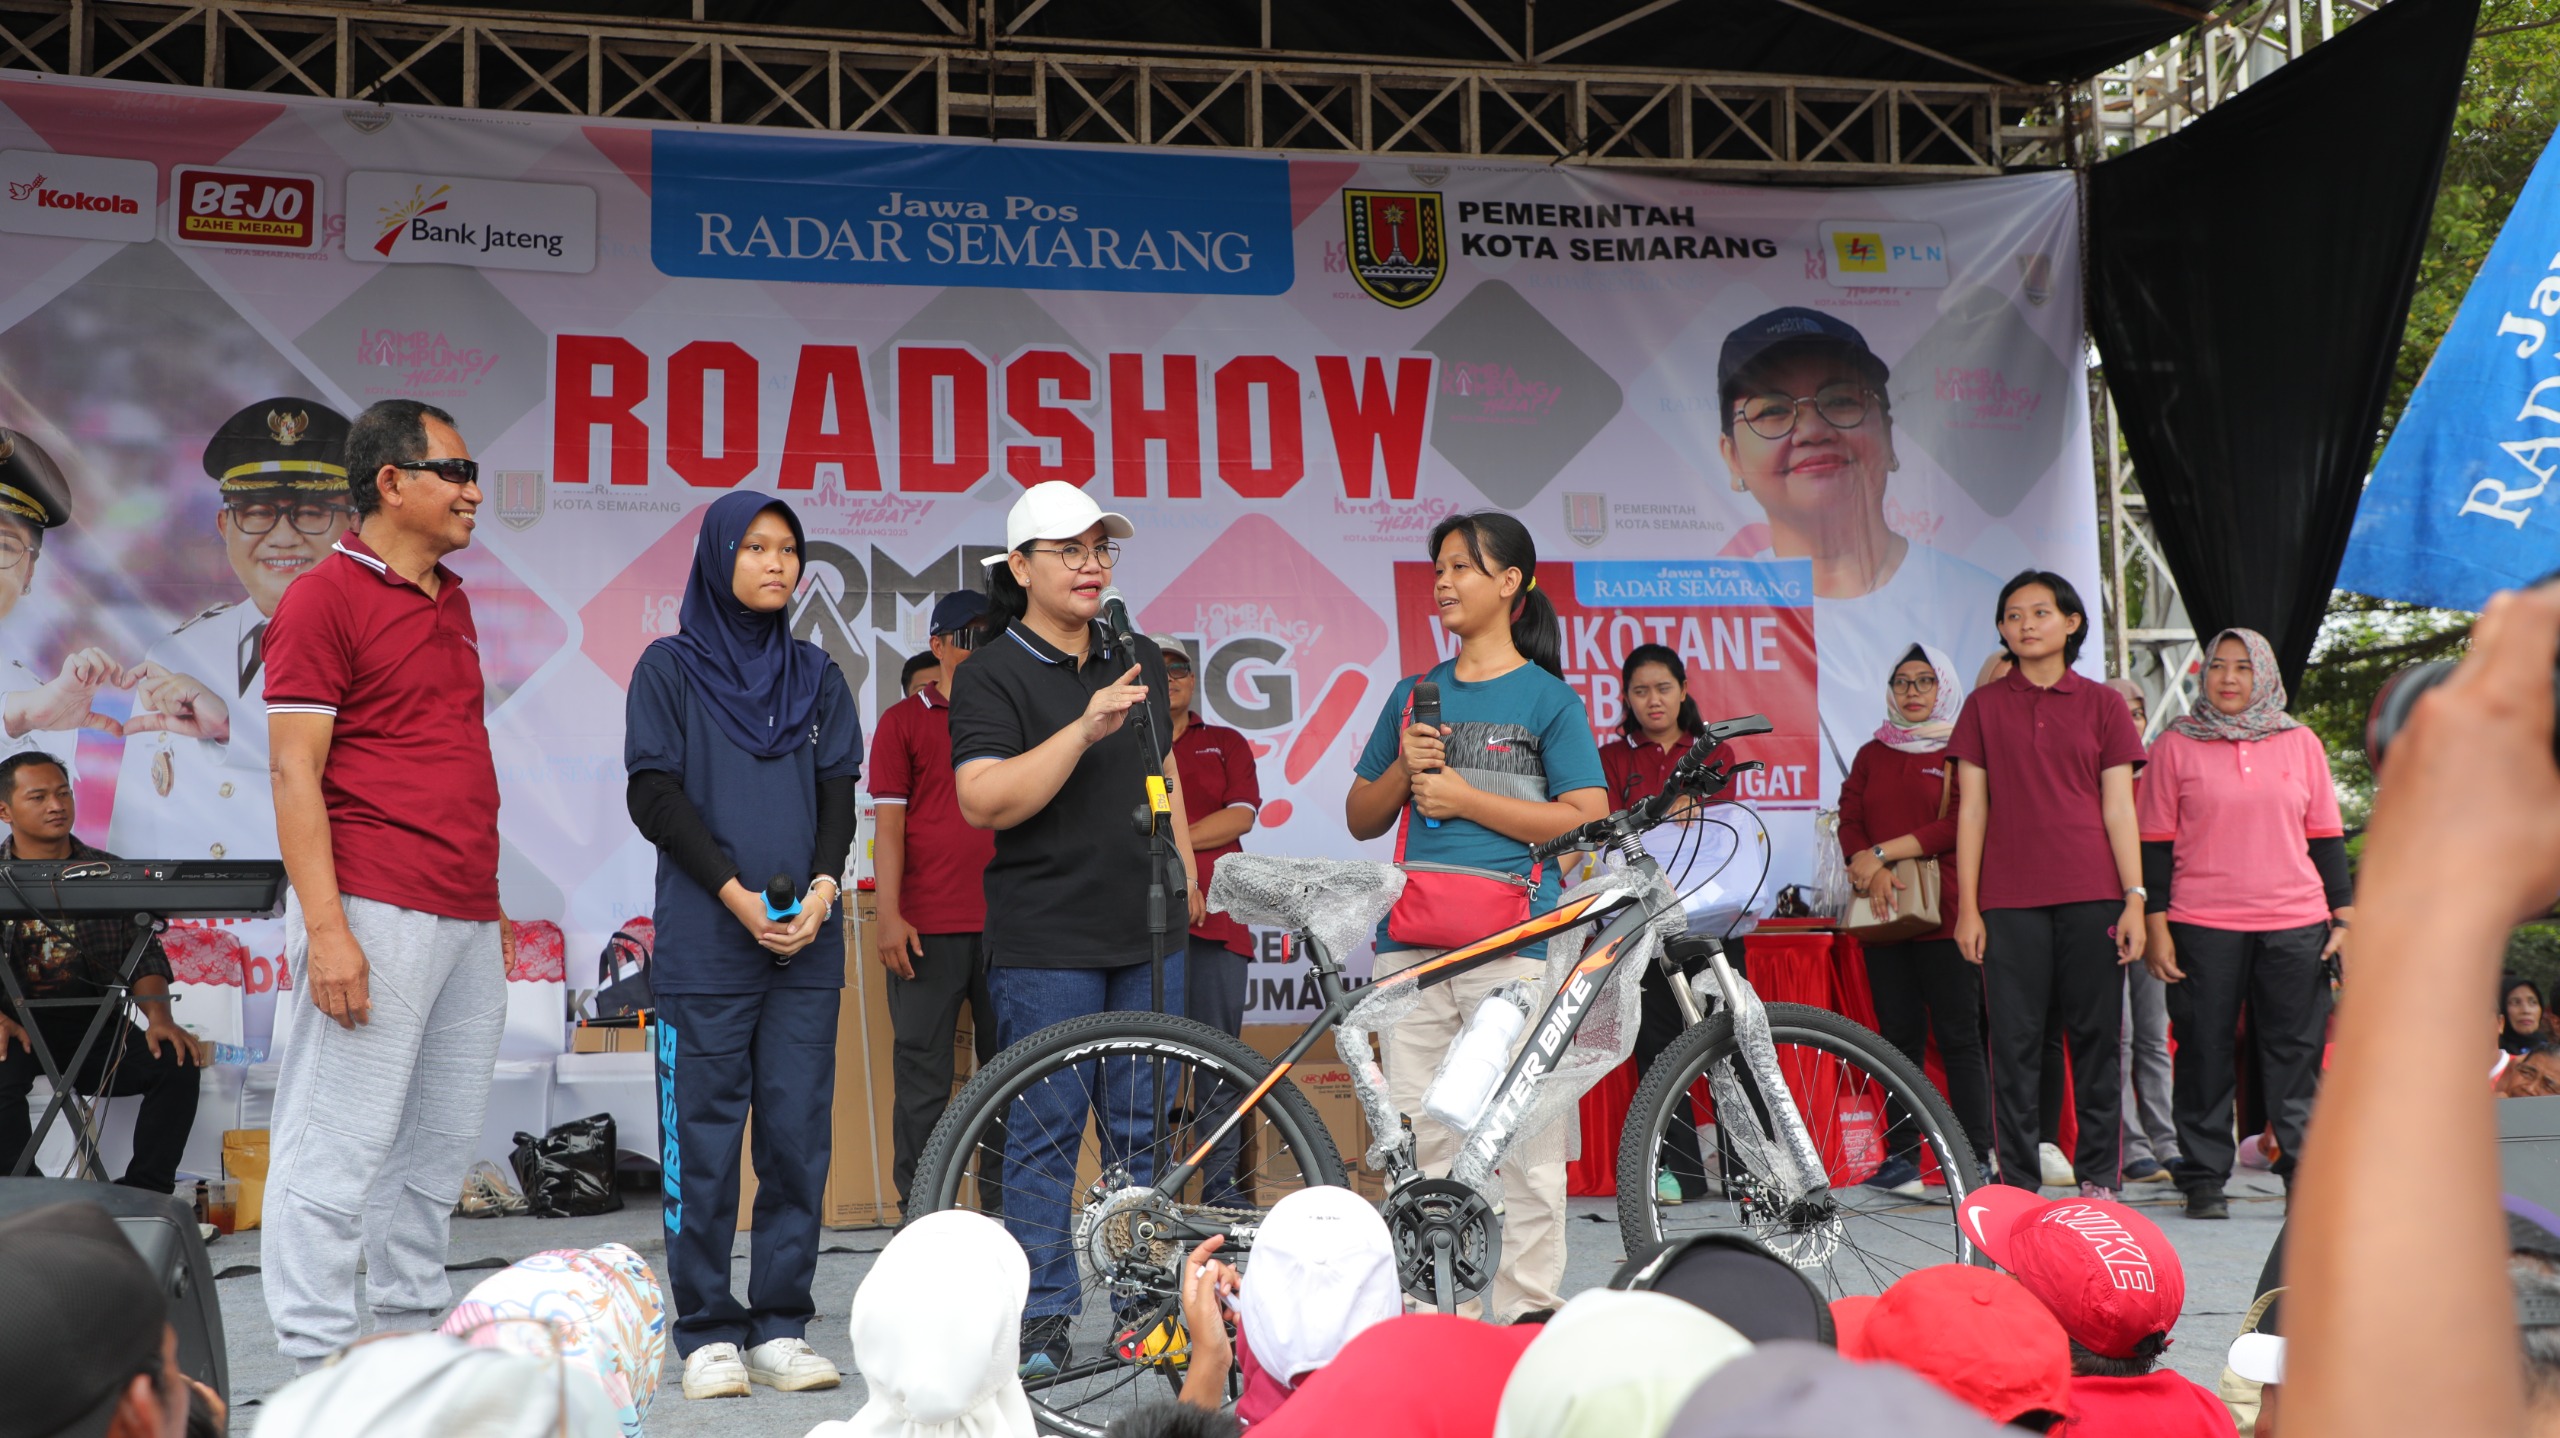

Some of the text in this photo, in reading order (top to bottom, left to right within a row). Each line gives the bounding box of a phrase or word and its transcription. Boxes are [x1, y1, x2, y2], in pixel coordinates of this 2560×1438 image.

[38, 189, 139, 214] Kokola
[190, 180, 304, 221] BEJO
[878, 192, 1079, 222] Jawa Pos
[192, 218, 295, 235] JAHE MERAH
[1458, 201, 1696, 229] PEMERINTAH
[411, 218, 477, 245] Bank
[481, 224, 564, 257] Jateng
[695, 212, 1253, 273] RADAR SEMARANG
[1461, 233, 1778, 262] KOTA SEMARANG
[1892, 245, 1943, 262] PLN
[552, 333, 1433, 500] ROADSHOW
[553, 499, 682, 513] KOTA SEMARANG
[1614, 503, 1696, 516] PEMERINTAH
[1615, 519, 1725, 532] KOTA SEMARANG
[1656, 567, 1741, 579] Jawa Pos
[1594, 580, 1801, 599] RADAR SEMARANG
[1062, 1041, 1224, 1069] INTER BIKE
[1476, 970, 1593, 1162] INTER BIKE
[2041, 1204, 2155, 1292] NIKE
